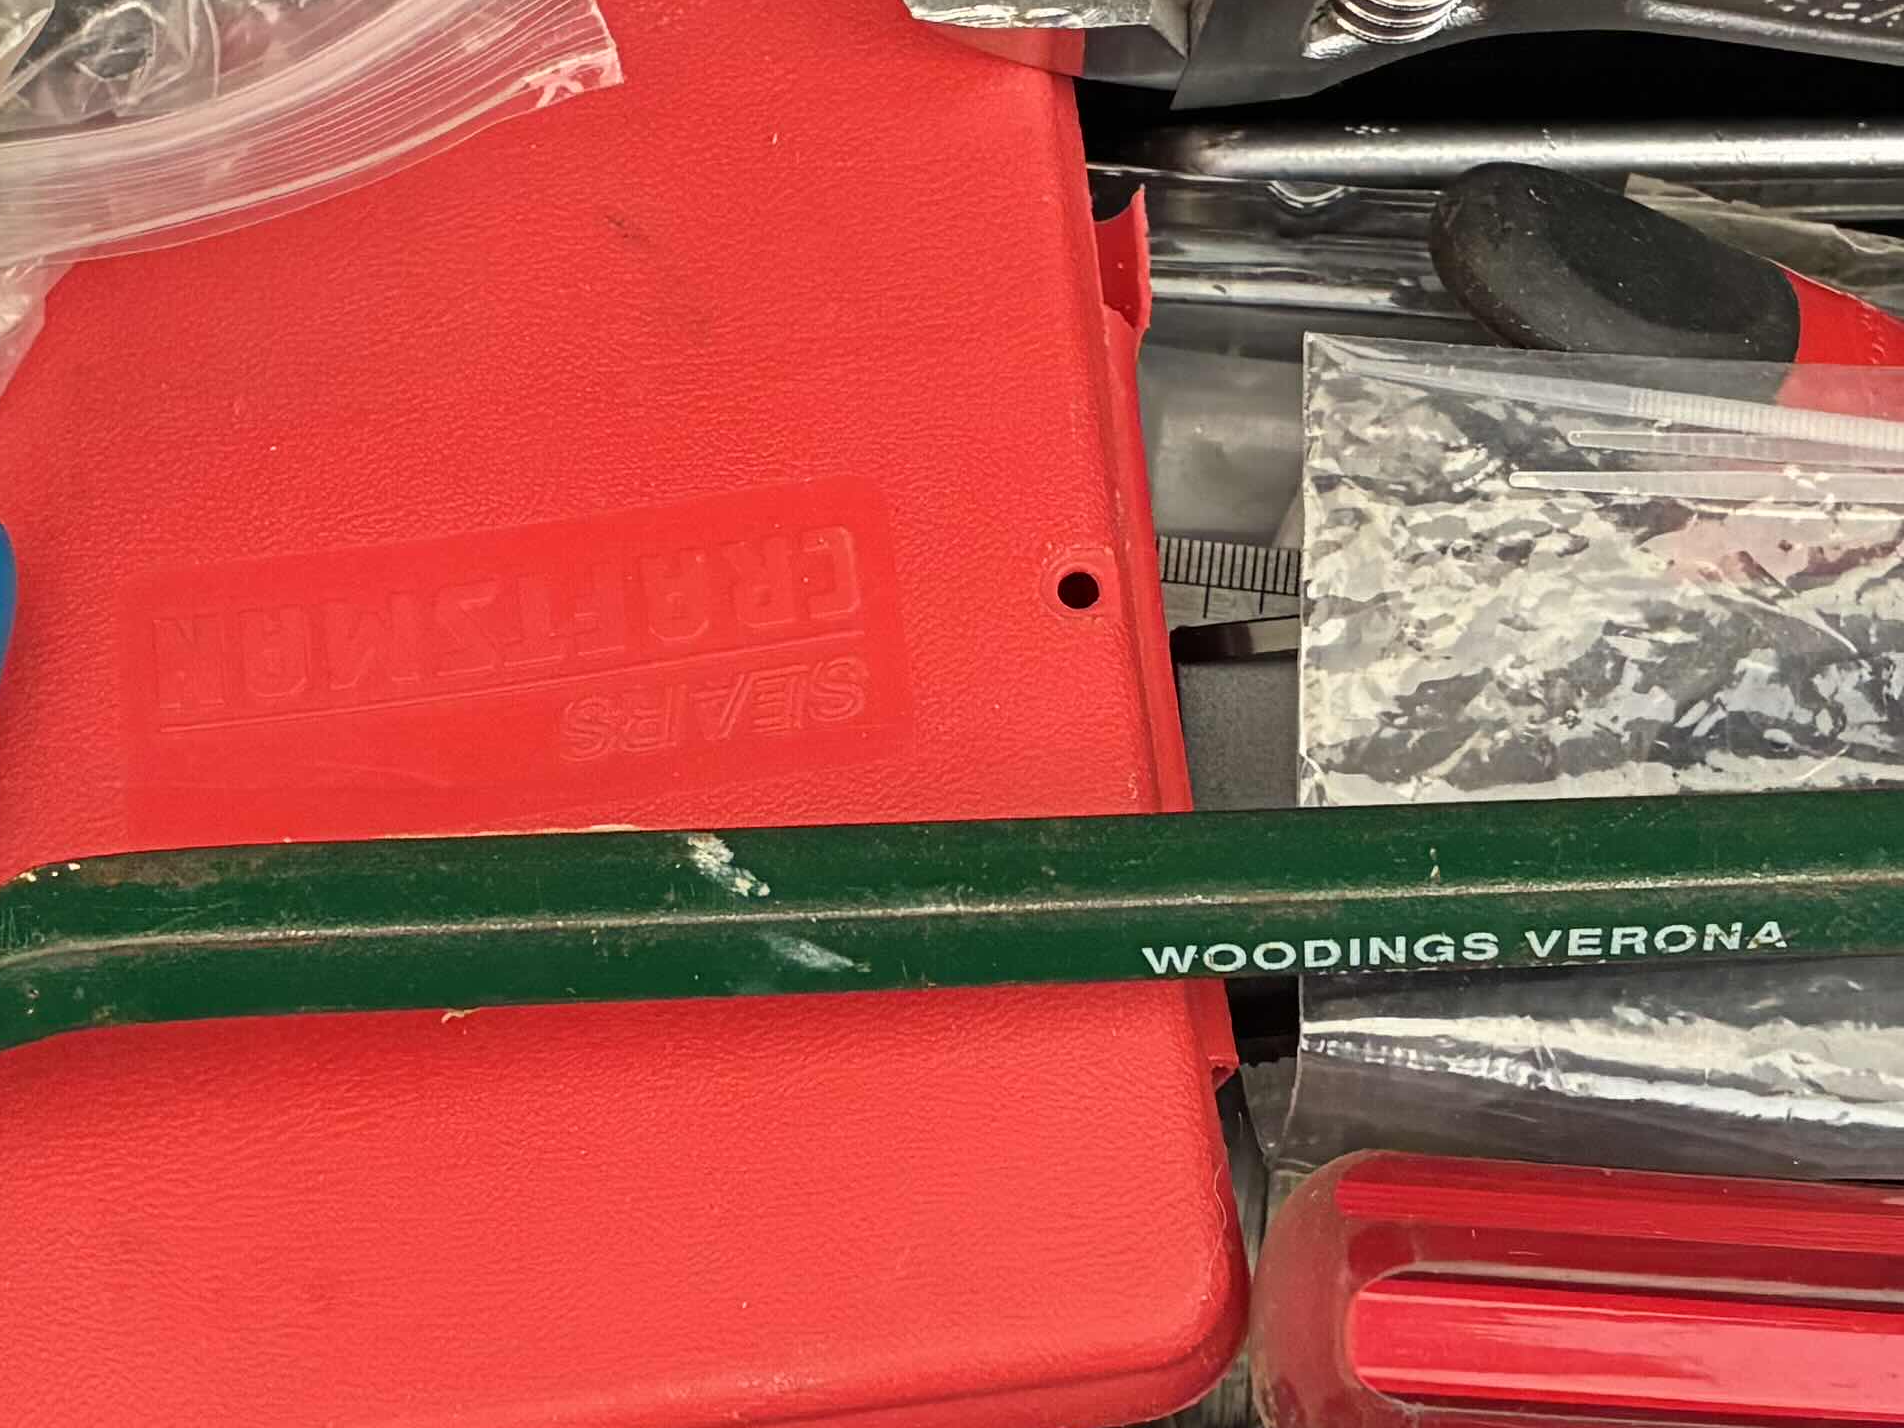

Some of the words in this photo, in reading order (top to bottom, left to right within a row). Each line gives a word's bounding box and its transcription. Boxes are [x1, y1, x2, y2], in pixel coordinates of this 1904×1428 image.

[151, 525, 862, 709] CRAFTSMAN
[1141, 931, 1501, 975] WOODINGS
[1523, 919, 1790, 960] VERONA
